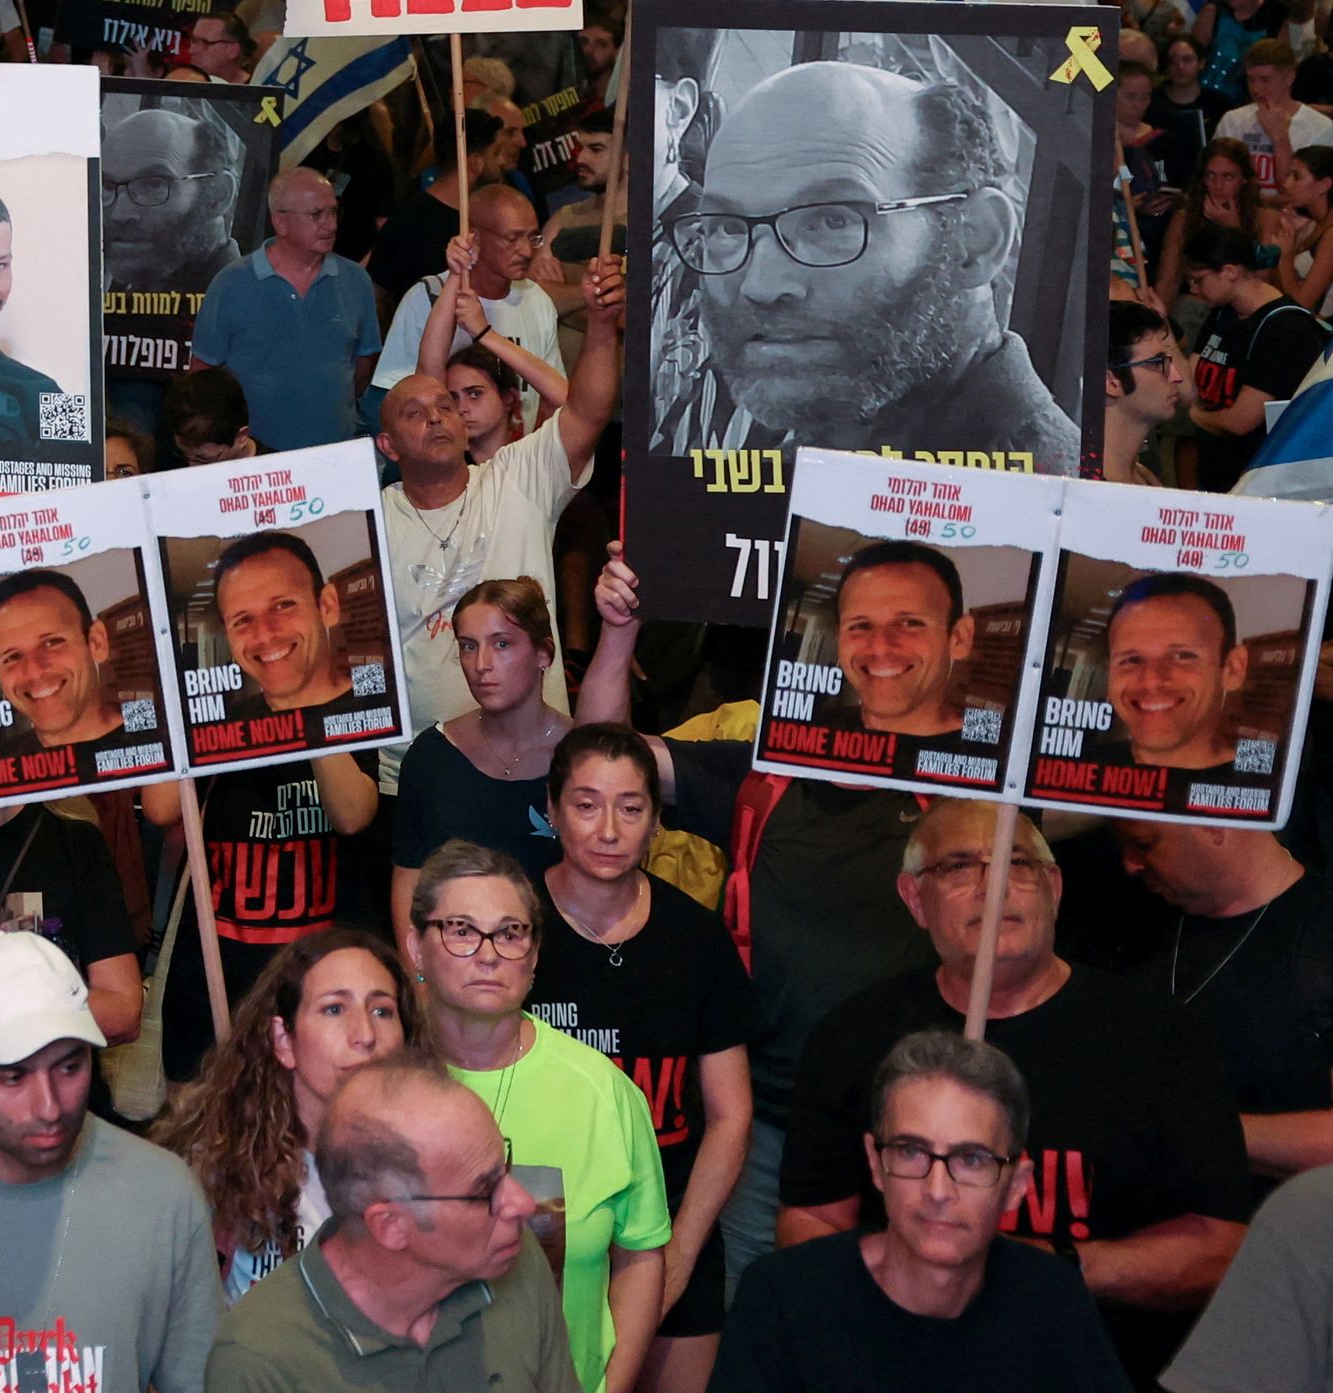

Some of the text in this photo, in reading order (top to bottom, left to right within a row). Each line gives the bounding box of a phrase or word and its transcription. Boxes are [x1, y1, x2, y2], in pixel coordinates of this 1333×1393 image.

[151, 28, 182, 56] גיא
[132, 291, 181, 314] למוות
[36, 462, 53, 476] AND
[55, 463, 92, 478] MISSING
[228, 469, 292, 495] אוהד יהלומי
[689, 448, 785, 493] בשבי
[219, 487, 307, 514] OHAD YAHALOMI
[886, 476, 962, 502] אוהד יהלומי
[27, 508, 59, 530] אוהד
[289, 497, 324, 521] 50
[870, 494, 972, 522] OHAD YAHALOMI
[1158, 507, 1235, 532] אוהד יהלומי
[18, 526, 73, 548] YAHALOMI
[940, 522, 976, 540] 50
[1141, 525, 1246, 553] OHAD YAHALOMI
[61, 535, 91, 557] 50
[1215, 550, 1250, 570] 50
[184, 664, 242, 697] BRING
[776, 660, 843, 693] BRING
[189, 693, 226, 724] HIM
[772, 690, 814, 723] HIM
[1044, 696, 1112, 730] BRING
[193, 709, 305, 752] HOME NOW!
[324, 715, 393, 739] FAMILIES FORUM
[767, 726, 896, 764] HOME NOW!
[1041, 726, 1084, 758] HIM
[21, 745, 77, 782] NOW!
[96, 750, 165, 773] FAMILIES FORUM
[916, 760, 996, 783] FAMILIES FORUM
[1036, 758, 1167, 798] HOME NOW!
[1187, 793, 1268, 812] FAMILIES FORUM
[249, 810, 294, 839] הביתה
[531, 1002, 578, 1027] BRING
[577, 1028, 621, 1053] HOME
